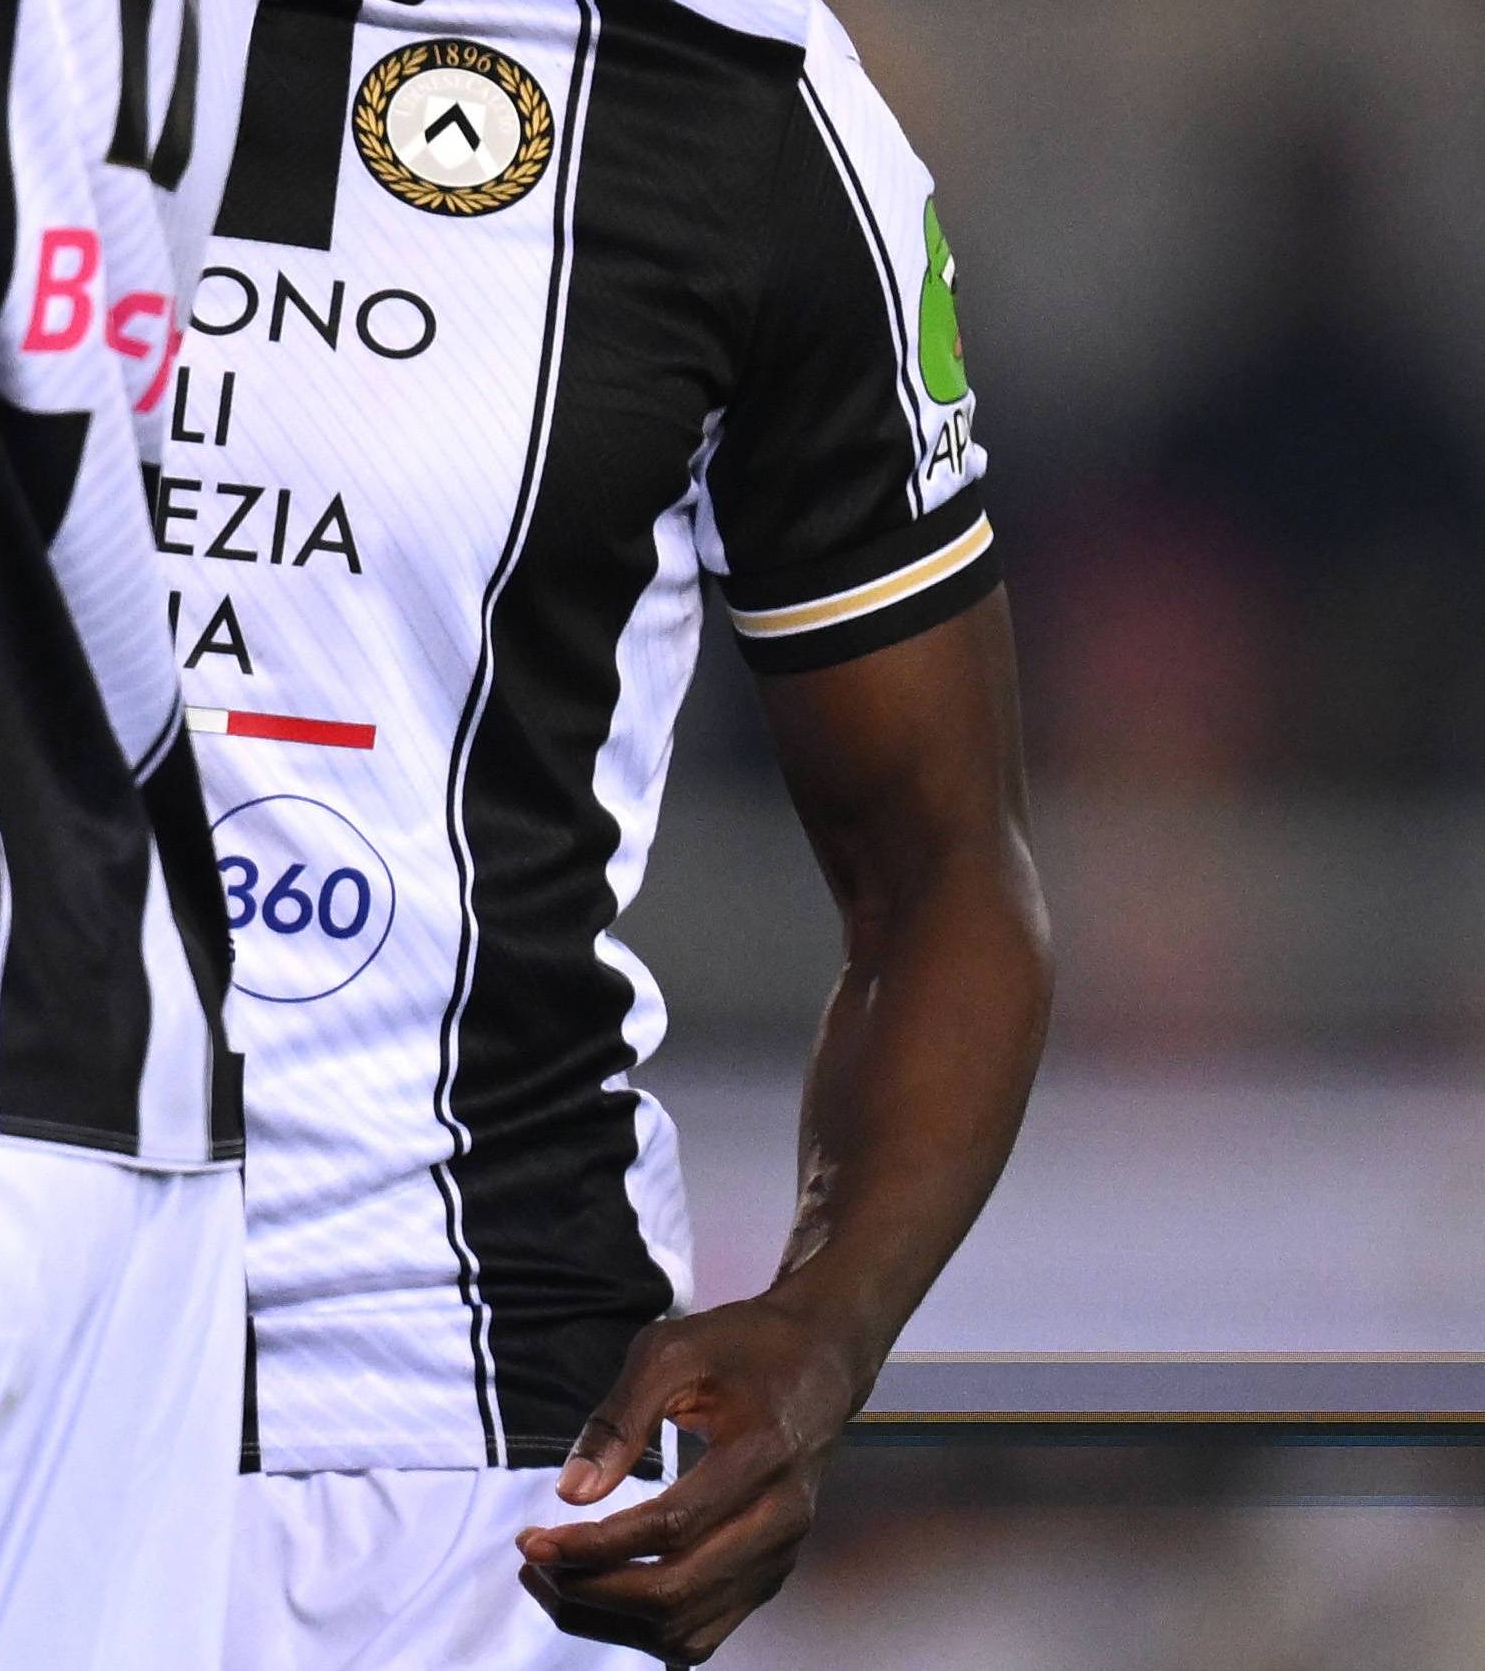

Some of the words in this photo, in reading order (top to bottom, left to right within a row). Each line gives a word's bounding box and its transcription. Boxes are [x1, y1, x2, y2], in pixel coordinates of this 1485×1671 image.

[433, 43, 492, 73] 1896
[190, 266, 436, 359] ONO
[926, 408, 970, 480] AP
[157, 476, 362, 574] EZIA
[217, 855, 371, 939] 360
